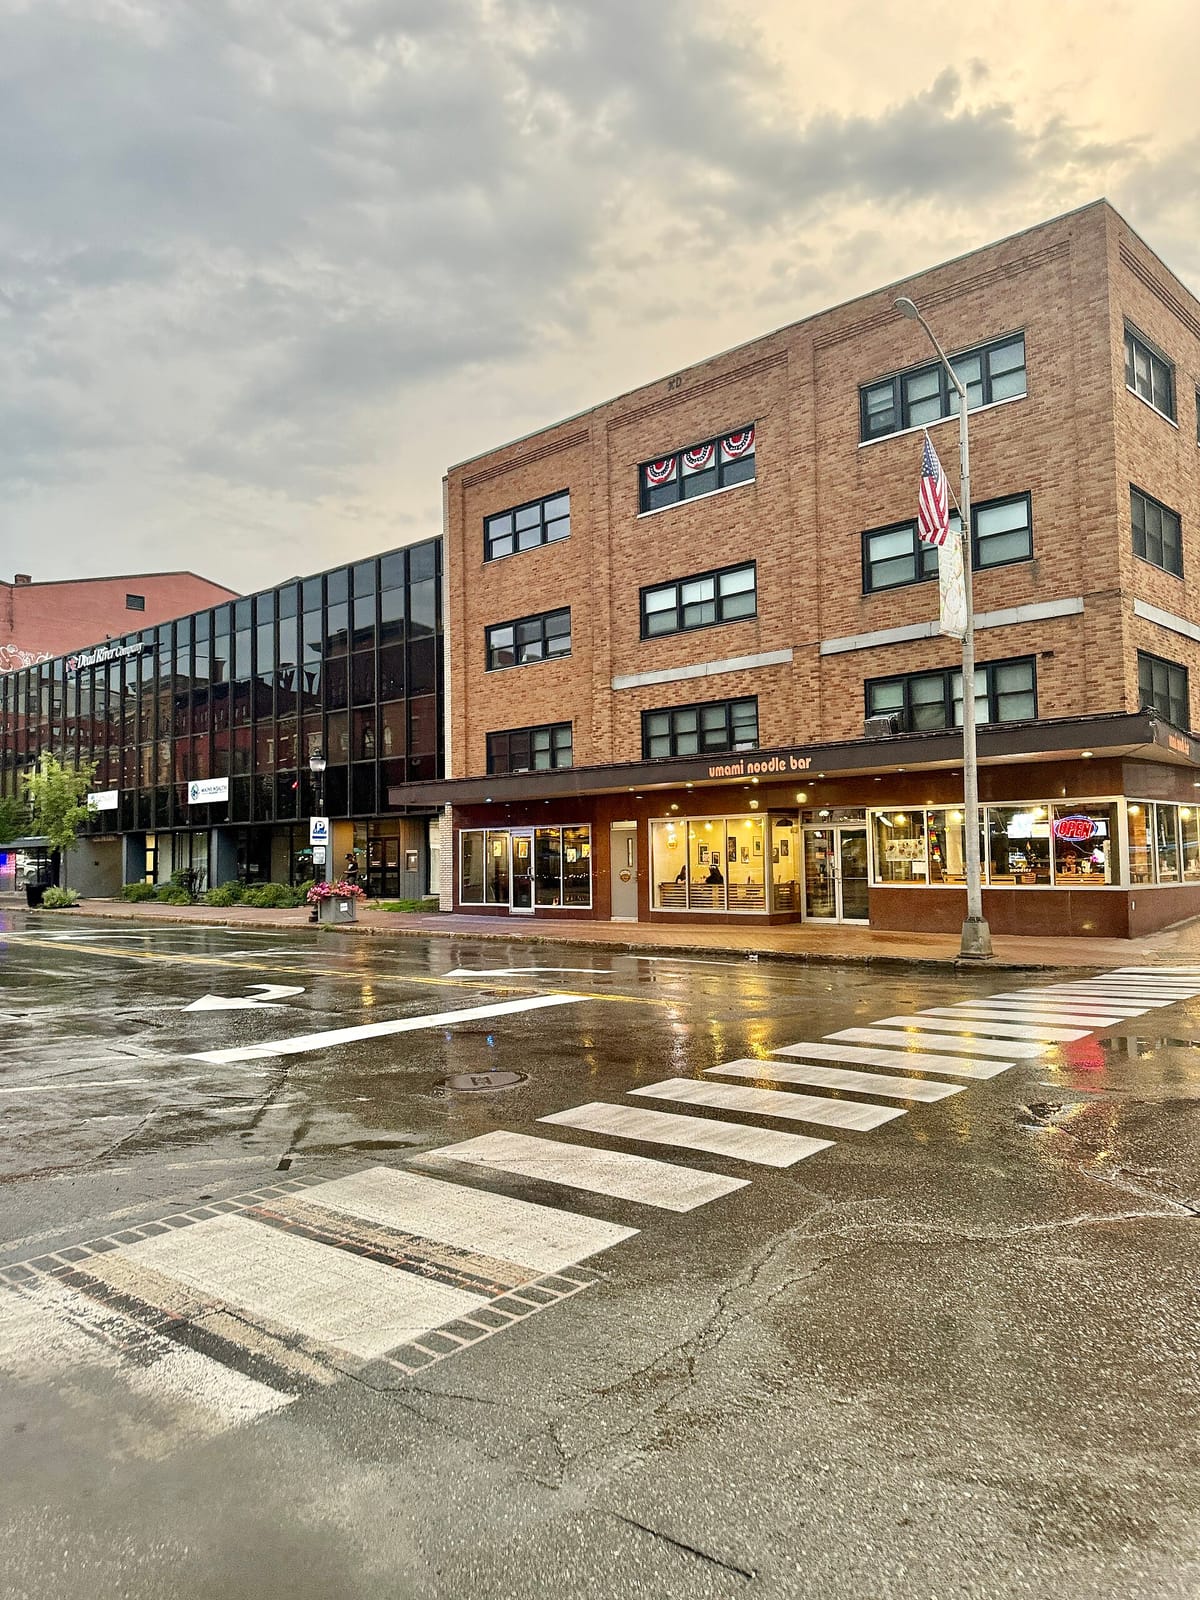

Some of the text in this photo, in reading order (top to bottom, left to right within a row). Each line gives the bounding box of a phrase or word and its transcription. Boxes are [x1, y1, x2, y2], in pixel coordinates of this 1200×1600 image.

[77, 642, 145, 669] Dead River Company
[708, 755, 812, 777] umami noodle bar
[1059, 820, 1093, 839] OPEN
